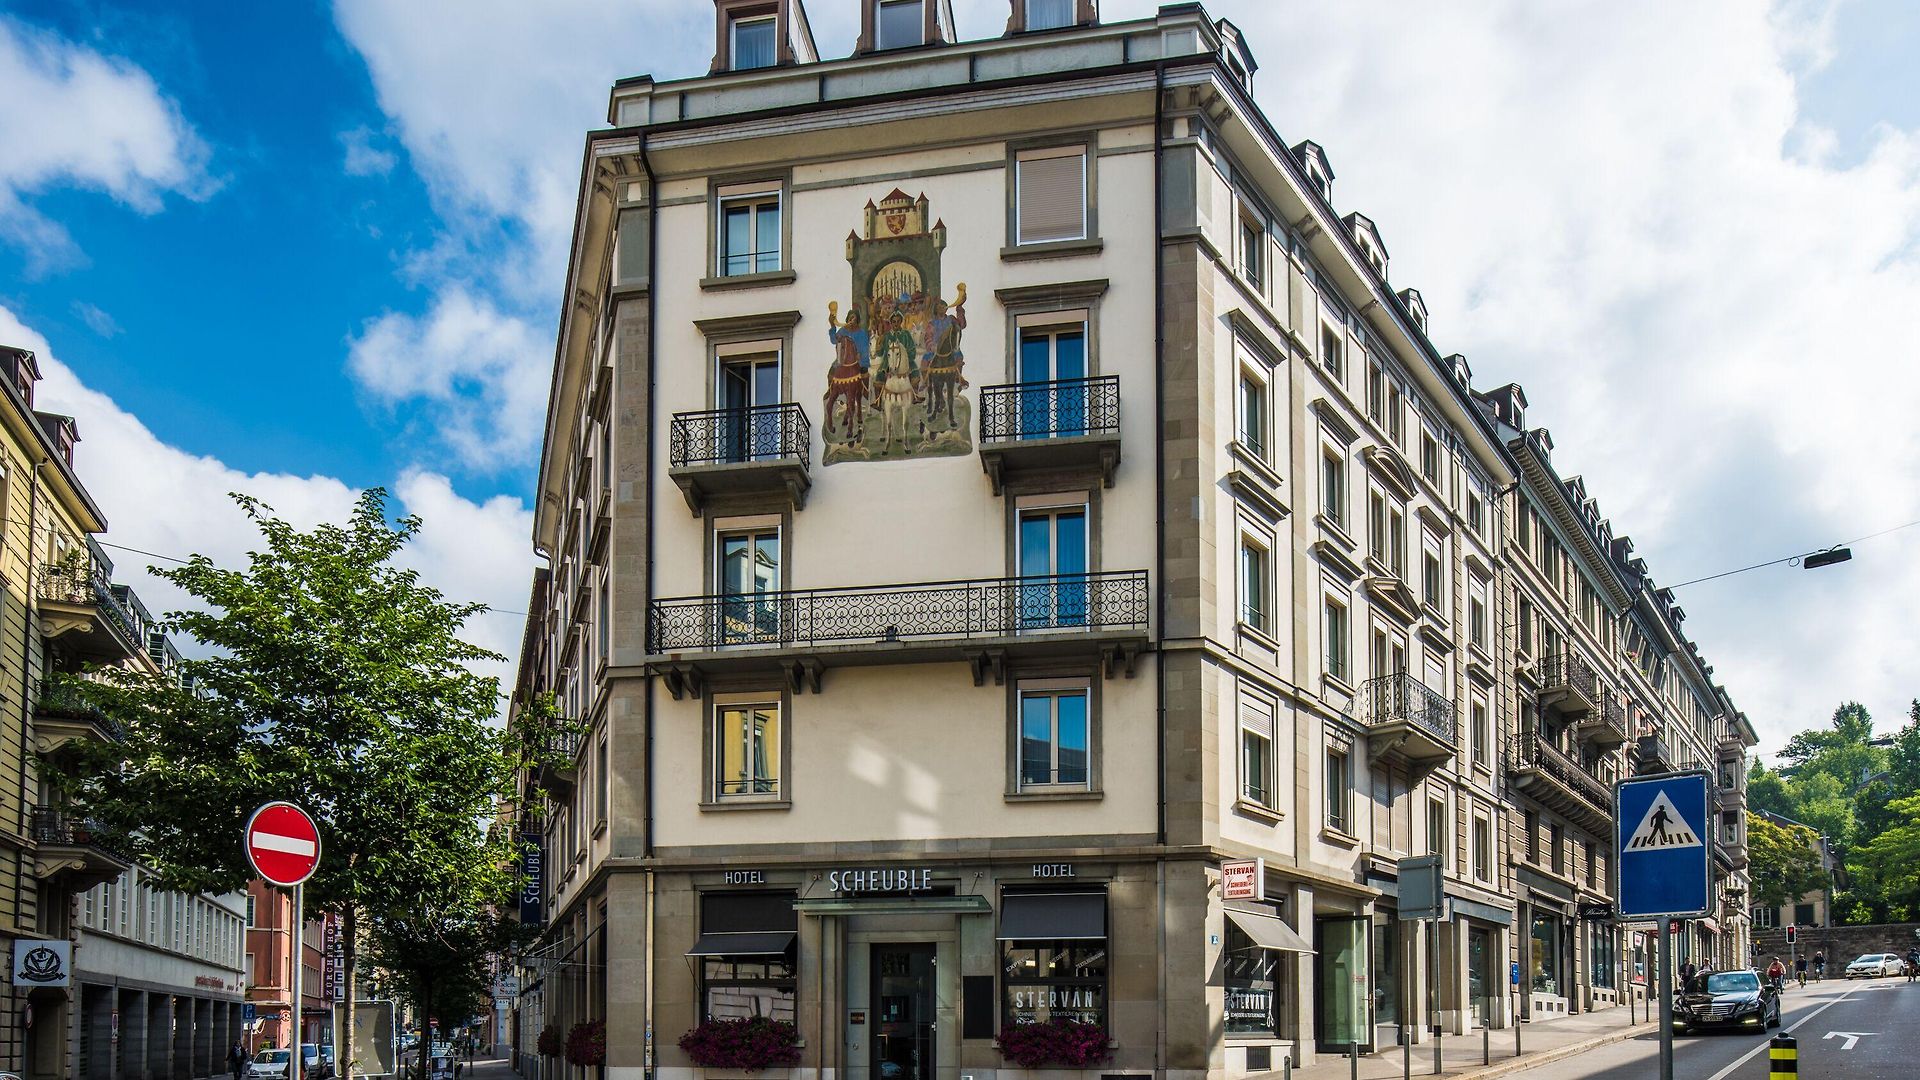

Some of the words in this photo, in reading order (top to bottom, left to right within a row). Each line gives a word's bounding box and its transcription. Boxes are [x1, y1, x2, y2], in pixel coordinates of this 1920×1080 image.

[524, 846, 540, 904] SCHEUBL
[725, 871, 764, 884] HOTEL
[1033, 864, 1075, 877] HOTEL
[1225, 866, 1255, 876] STERVAN
[829, 869, 932, 892] SCHEUBLE
[1016, 991, 1093, 1008] STERVAN
[1231, 993, 1265, 1010] STERVAN
